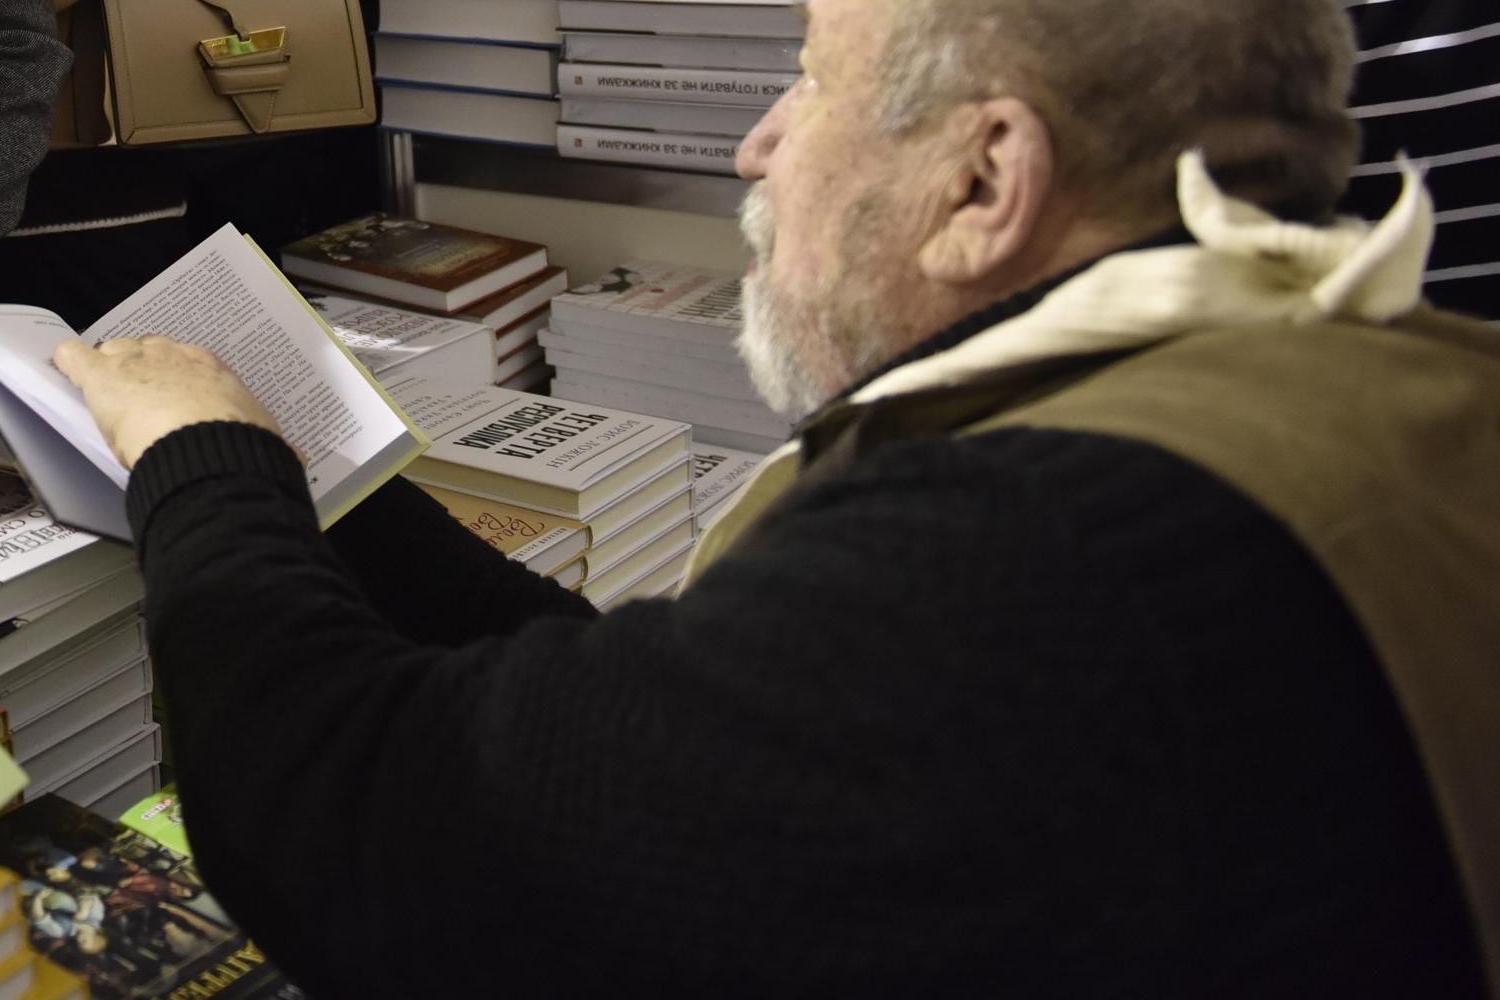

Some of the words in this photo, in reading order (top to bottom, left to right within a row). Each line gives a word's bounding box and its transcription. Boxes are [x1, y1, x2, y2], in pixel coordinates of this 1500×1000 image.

[598, 76, 661, 90] книжками
[664, 79, 678, 90] за
[682, 81, 697, 90] не
[701, 81, 758, 94] готувати
[597, 138, 660, 152] книжками
[664, 142, 677, 154] за
[681, 144, 697, 155] не
[453, 402, 566, 450] РЕСПУБЛІКА
[597, 419, 642, 443] БОРИС
[495, 412, 610, 459] ЧЕТВЕРТА
[546, 440, 599, 469] ЛОЖКІН
